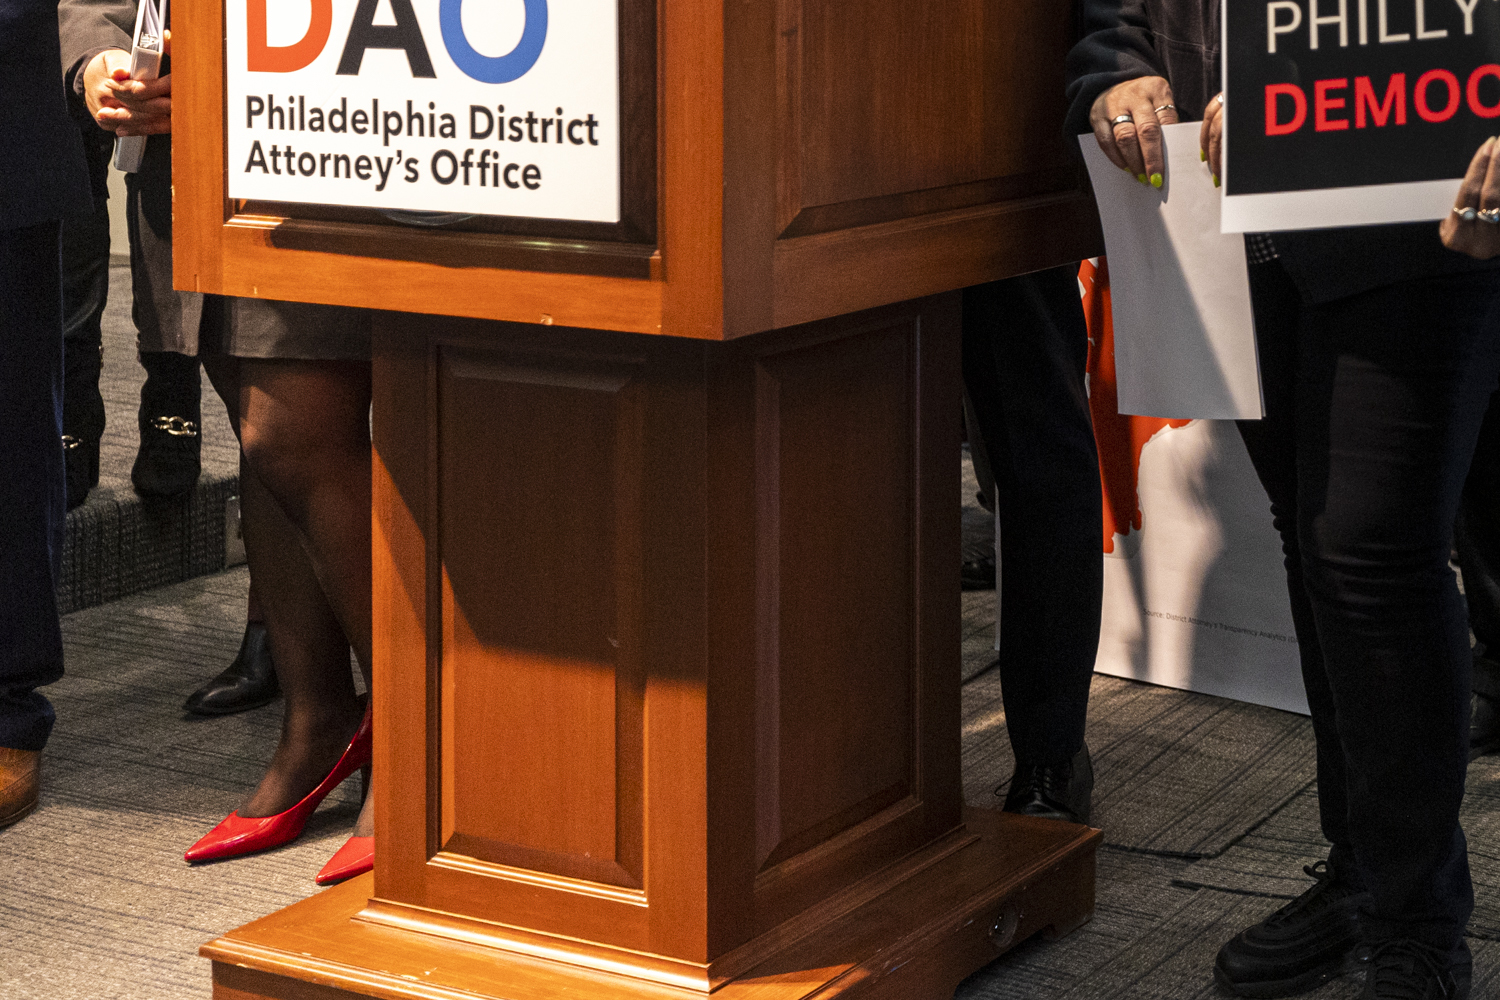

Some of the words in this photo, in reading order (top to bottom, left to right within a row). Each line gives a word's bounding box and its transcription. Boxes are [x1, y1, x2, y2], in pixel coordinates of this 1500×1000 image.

[246, 94, 457, 147] Philadelphia
[469, 104, 600, 146] District
[244, 140, 420, 192] Attorney's
[430, 148, 543, 190] Office
